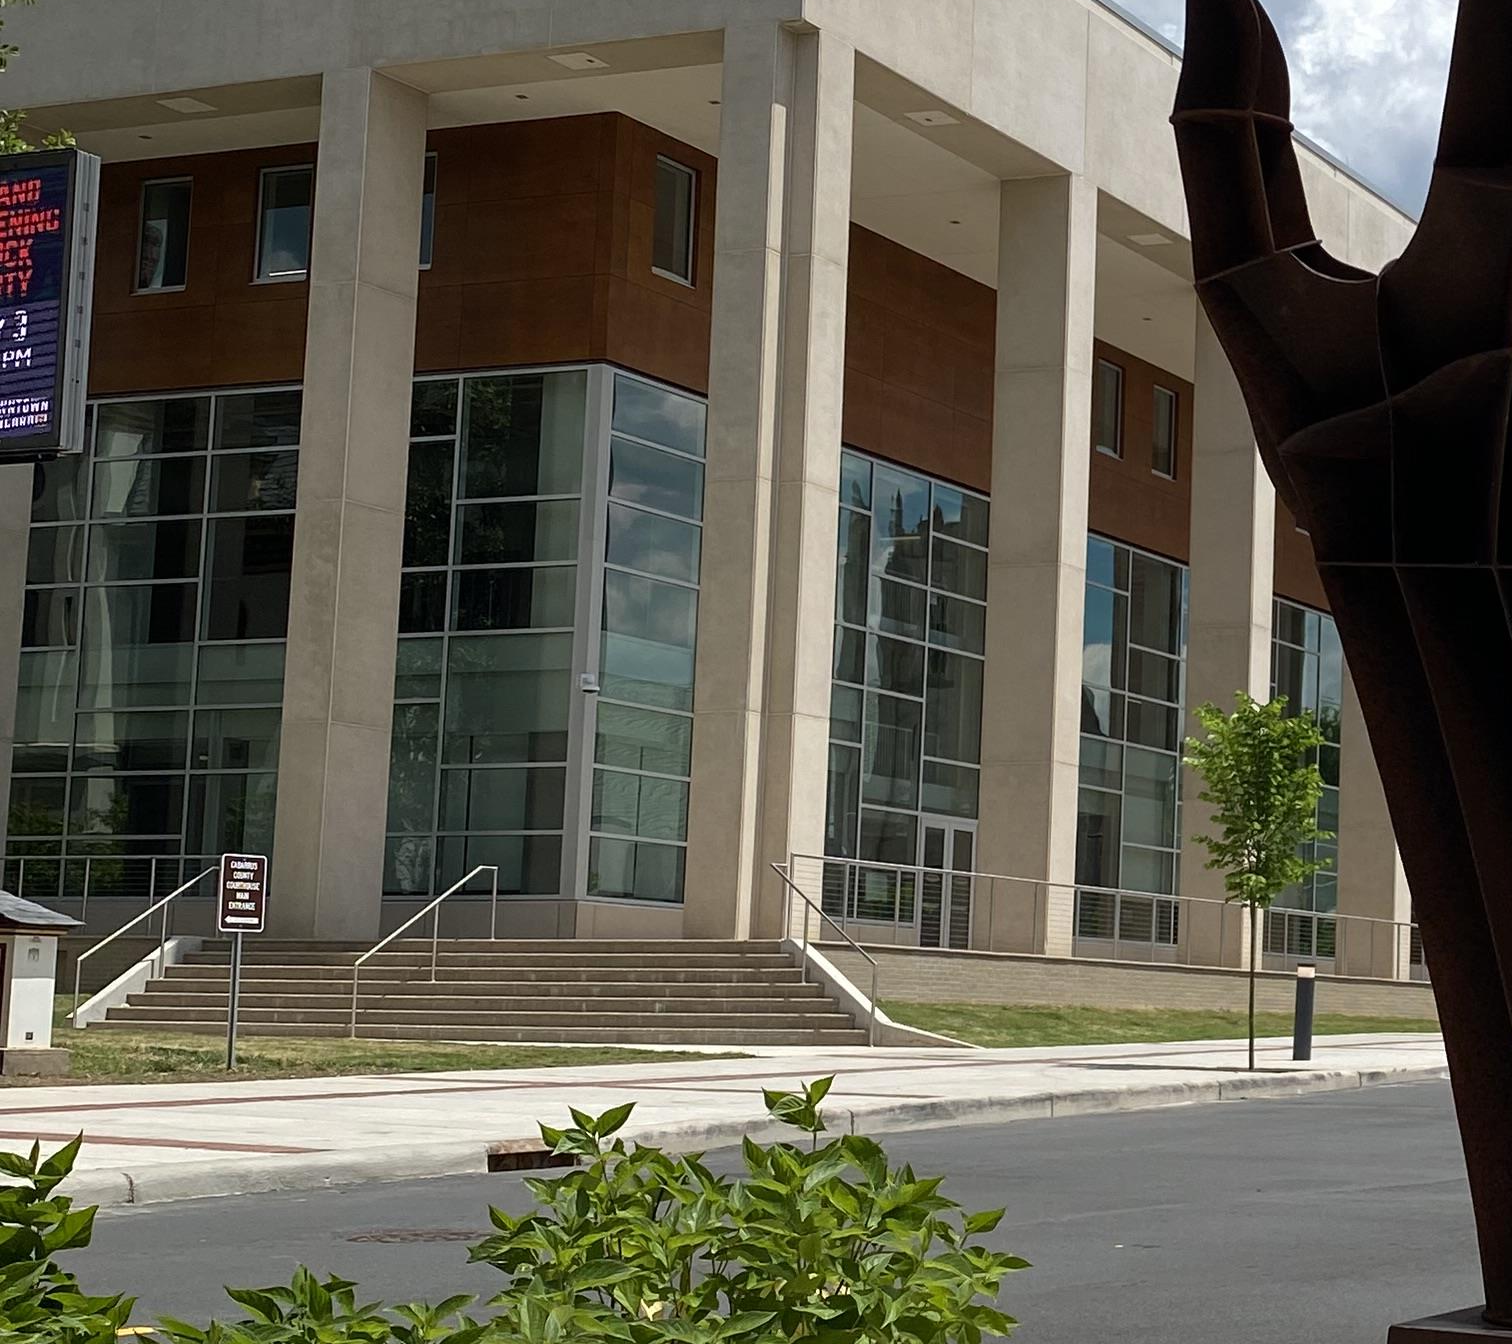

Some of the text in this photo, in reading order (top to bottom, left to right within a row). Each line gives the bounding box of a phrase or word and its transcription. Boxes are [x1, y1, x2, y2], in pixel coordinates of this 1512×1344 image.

[233, 871, 254, 880] COUNTY
[226, 881, 260, 891] COURTHOUSE
[236, 892, 249, 900] MAIN
[228, 901, 256, 910] ENTRANCE
